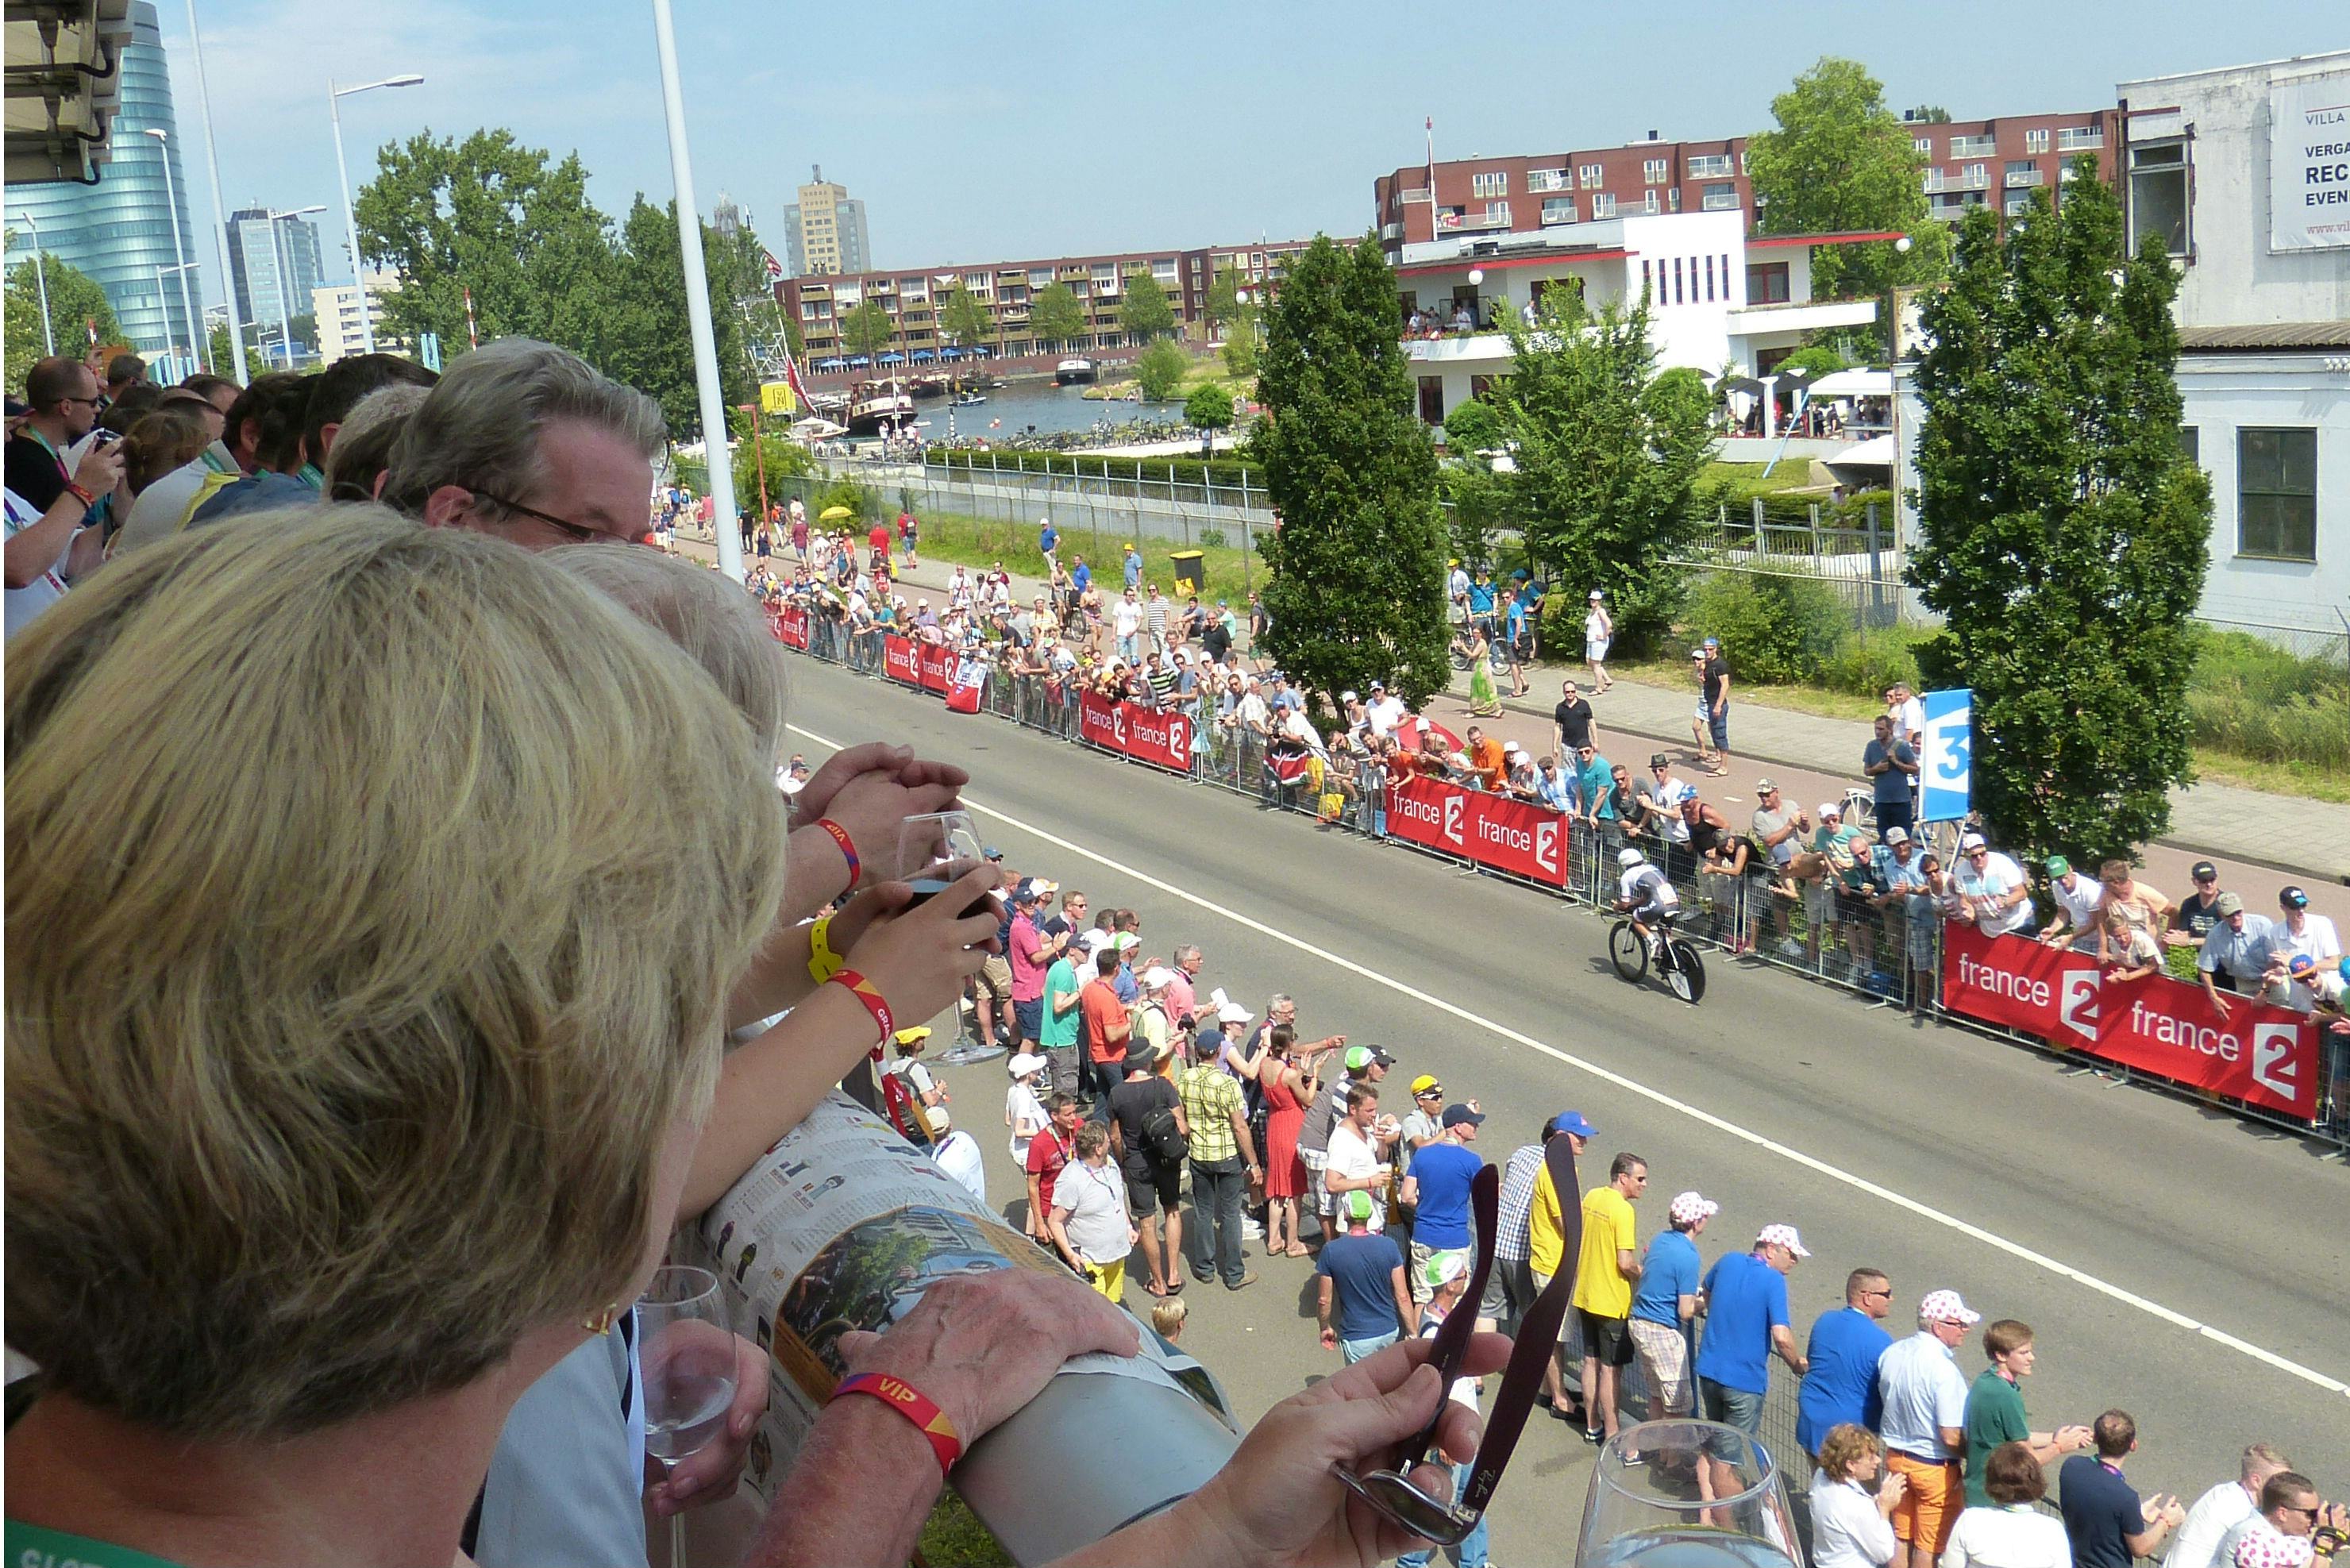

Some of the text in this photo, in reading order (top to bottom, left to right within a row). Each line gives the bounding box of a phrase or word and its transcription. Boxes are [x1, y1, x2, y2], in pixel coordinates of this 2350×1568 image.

[2306, 113, 2345, 125] VILLA
[2306, 164, 2348, 184] REC
[2306, 190, 2350, 206] EVEN
[889, 648, 909, 667] france
[923, 657, 944, 677] france
[1086, 704, 1112, 730] france
[1133, 720, 1167, 746] france
[1937, 724, 1971, 780] 3
[826, 824, 846, 842] VIP
[1393, 791, 1440, 825] france
[1478, 814, 1531, 851] france
[1959, 953, 2050, 1007] france
[2132, 1000, 2239, 1061] france
[879, 1377, 918, 1402] VIP
